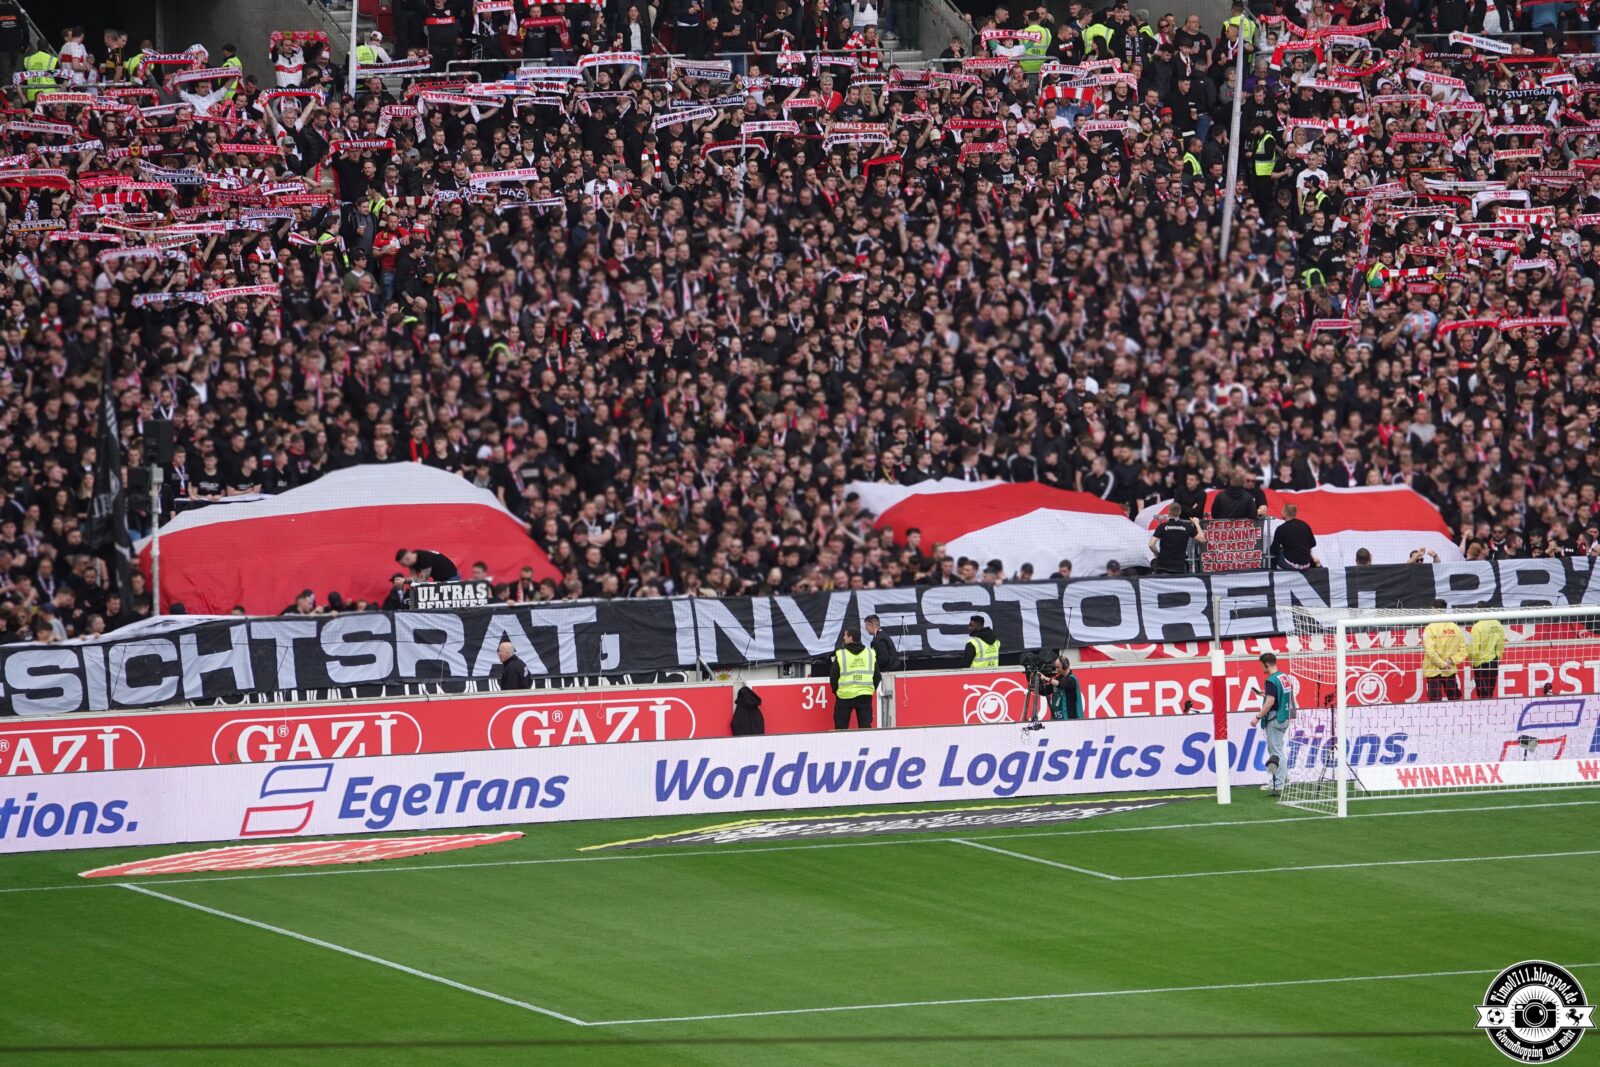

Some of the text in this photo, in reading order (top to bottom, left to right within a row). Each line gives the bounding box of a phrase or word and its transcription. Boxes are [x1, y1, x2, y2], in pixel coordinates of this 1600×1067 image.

[1440, 52, 1473, 60] Stuttgart
[1315, 79, 1360, 90] STUTTGART
[1505, 89, 1557, 99] STUTTGART
[833, 122, 862, 130] IEMALS
[237, 145, 277, 153] Stuttgart
[352, 139, 389, 149] STUTTGART
[294, 195, 329, 204] Stuttgart
[1208, 521, 1254, 530] JEDER
[1207, 541, 1256, 551] KEHRT
[417, 583, 487, 602] ULTRAS
[0, 606, 620, 717] SICHTSRAT,
[801, 685, 828, 710] 34
[1396, 764, 1504, 788] WINAMAX
[339, 772, 570, 830] EgeTrans
[655, 746, 927, 803] Worldwide
[938, 735, 1164, 797] Logistics
